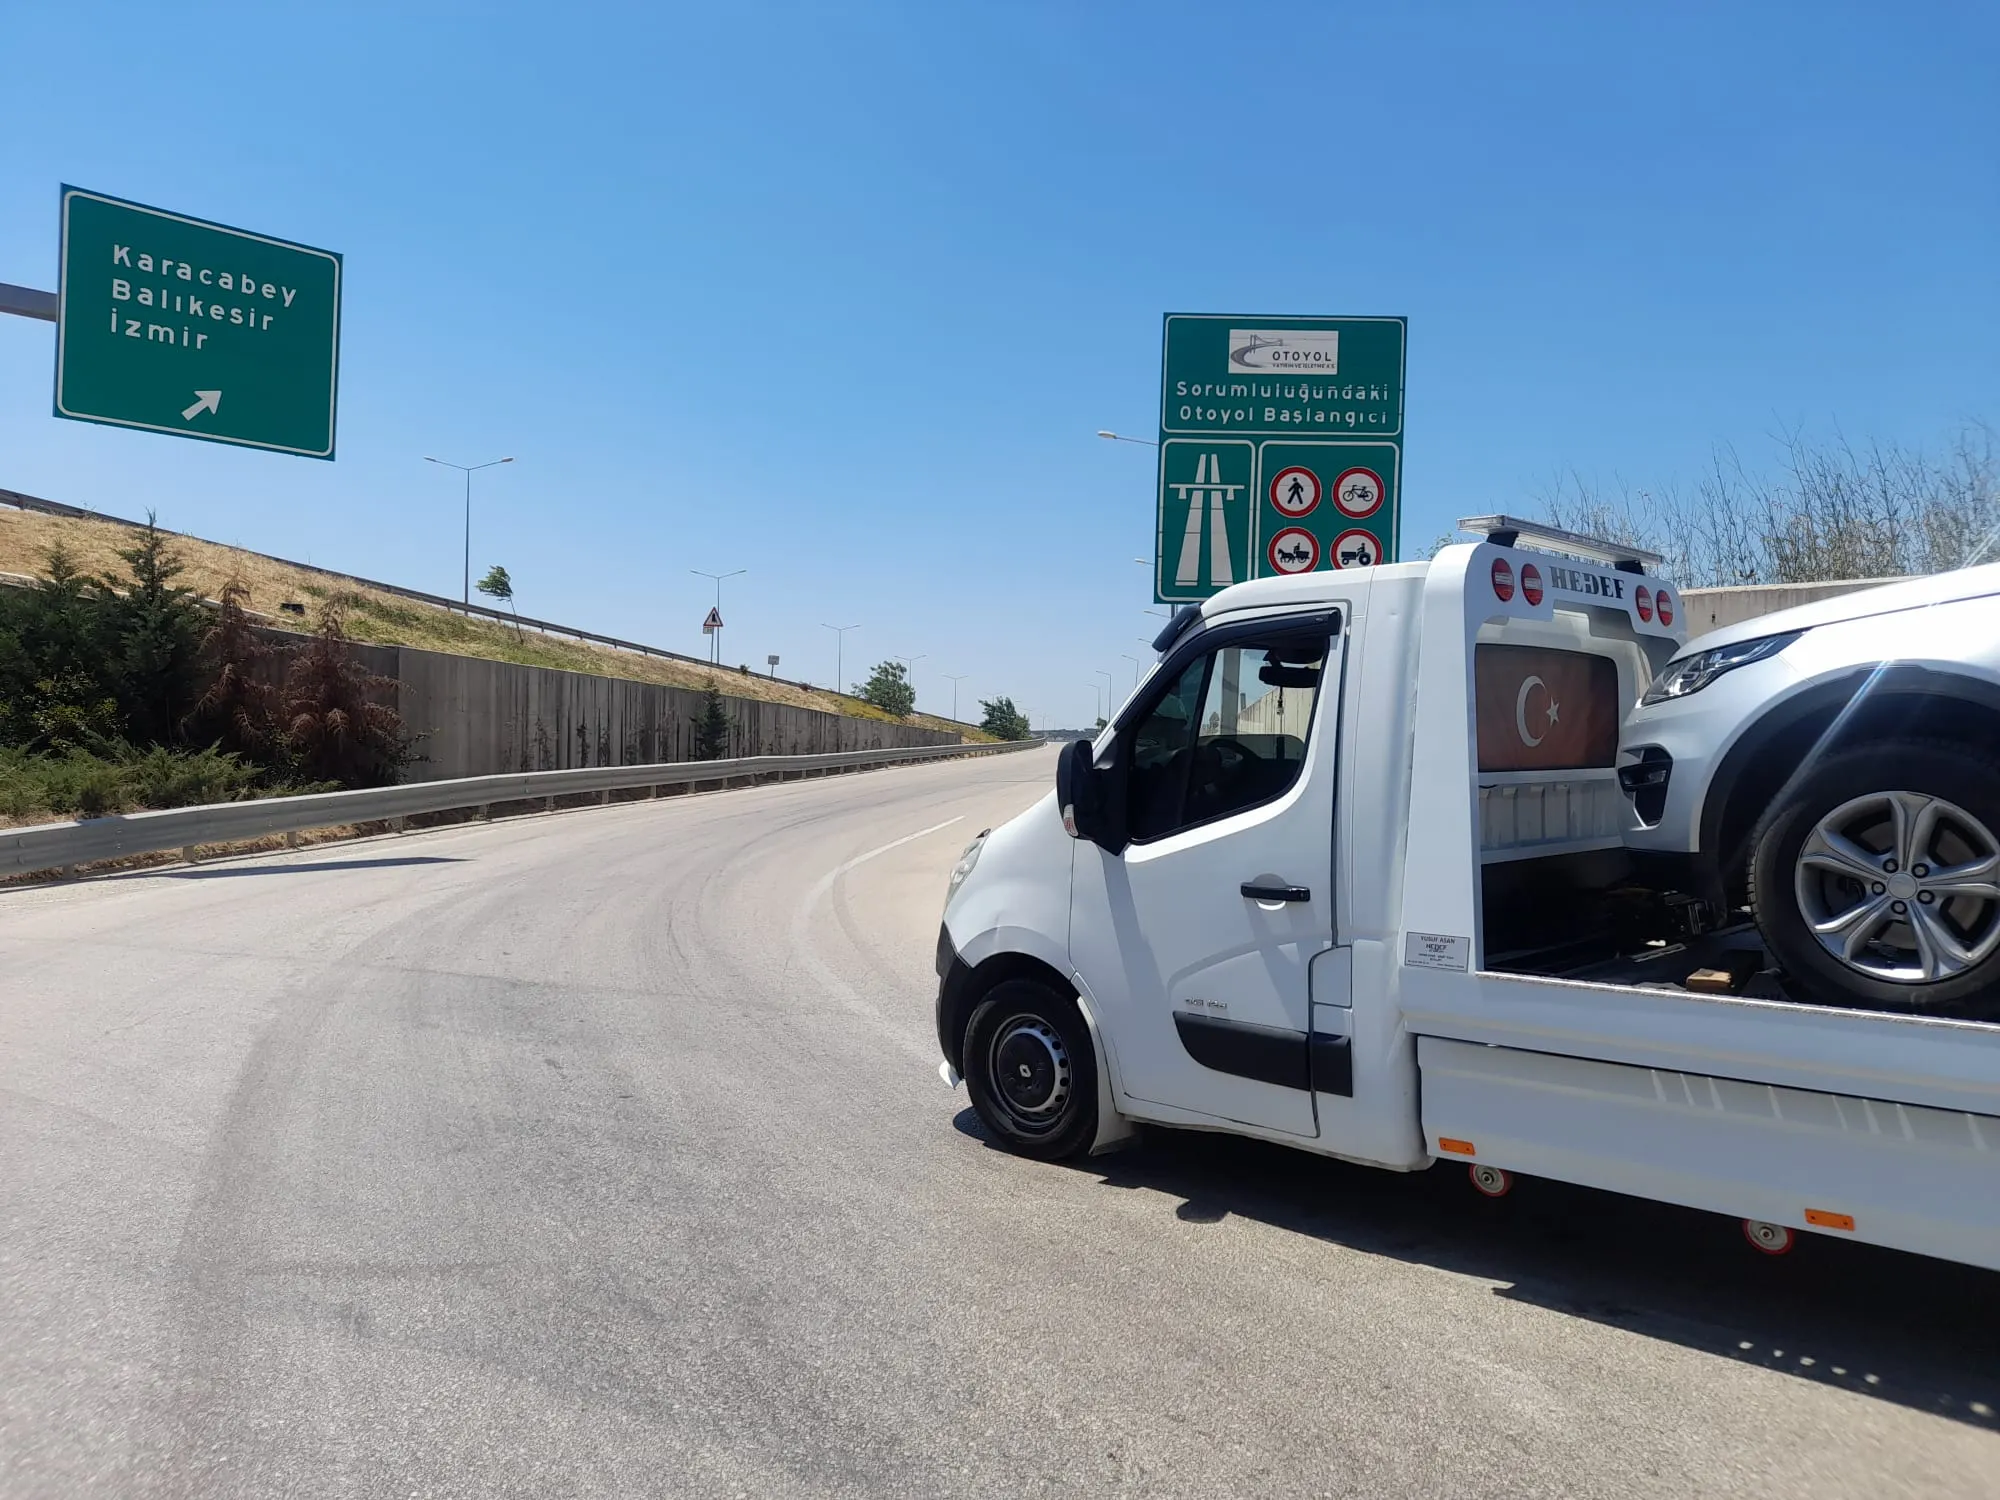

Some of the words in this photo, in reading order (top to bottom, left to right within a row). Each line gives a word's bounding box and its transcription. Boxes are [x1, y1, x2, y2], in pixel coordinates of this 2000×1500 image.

[112, 244, 297, 307] Karacabey
[111, 278, 274, 331] Balıkesir
[110, 307, 208, 349] İzmir
[1272, 351, 1332, 362] OTOYOL
[1176, 381, 1388, 403] Sorumluluğundaki
[1180, 405, 1253, 425] Otoyol
[1549, 566, 1625, 599] HEDEF
